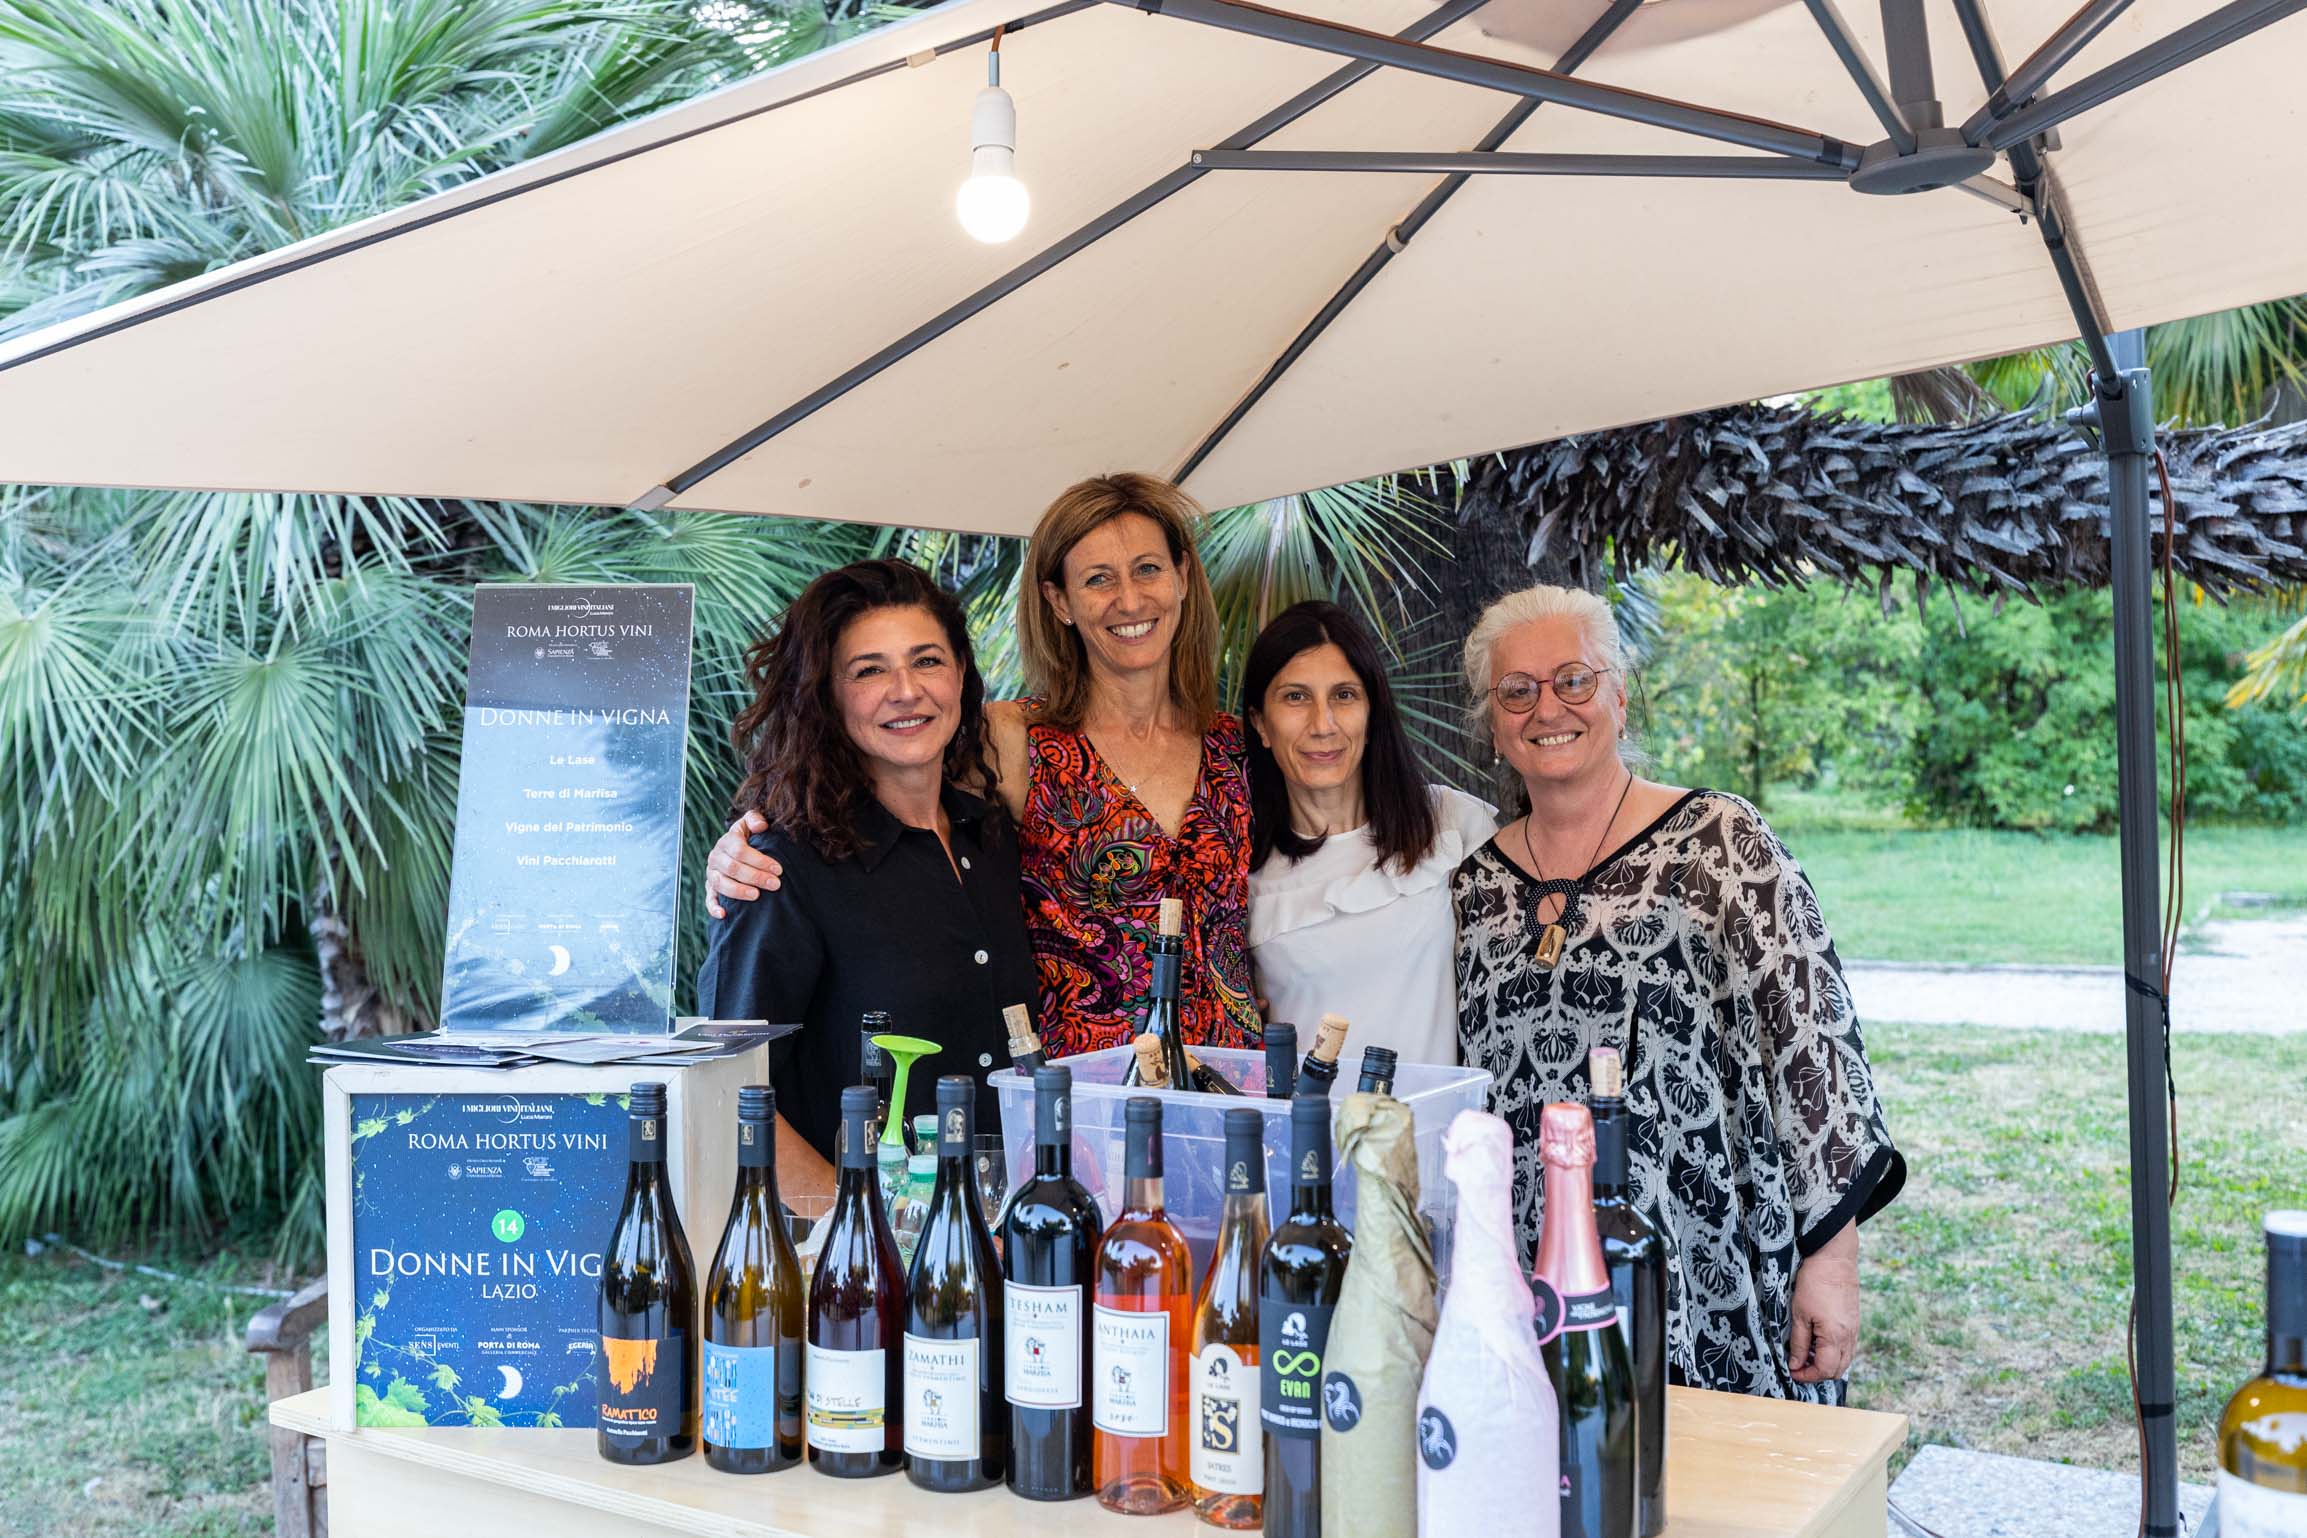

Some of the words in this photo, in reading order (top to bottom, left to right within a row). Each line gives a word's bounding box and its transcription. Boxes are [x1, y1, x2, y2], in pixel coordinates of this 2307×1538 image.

[507, 625, 551, 638] ROMA
[555, 625, 615, 638] HORTUS
[620, 624, 653, 637] VINI
[601, 708, 671, 726] VIGNA
[549, 755, 564, 765] Le
[567, 755, 595, 765] Lase
[524, 788, 554, 799] Terre
[558, 787, 570, 799] di
[574, 787, 618, 799] Marfisa
[505, 821, 540, 834] Vigne
[566, 821, 633, 833] Patrimonio
[516, 855, 540, 866] Vini
[543, 855, 616, 866] Pacchiarotti
[466, 1104, 501, 1112] MIGLIORI
[520, 1104, 553, 1112] ITALIANI
[408, 1133, 469, 1150] ROMA
[475, 1133, 556, 1151] HORTUS
[562, 1133, 608, 1150] VINI
[466, 1165, 503, 1174] SAPIENZA
[498, 1219, 518, 1235] 14
[545, 1249, 601, 1277] VIG
[482, 1283, 537, 1300] LAZIO
[1009, 1297, 1068, 1313] TESHAM
[408, 1341, 433, 1349] SENS
[477, 1341, 505, 1349] PORTA
[506, 1341, 516, 1349] DI
[517, 1341, 541, 1349] ROMA
[1280, 1378, 1311, 1399] EVAN
[1211, 1410, 1233, 1449] S
